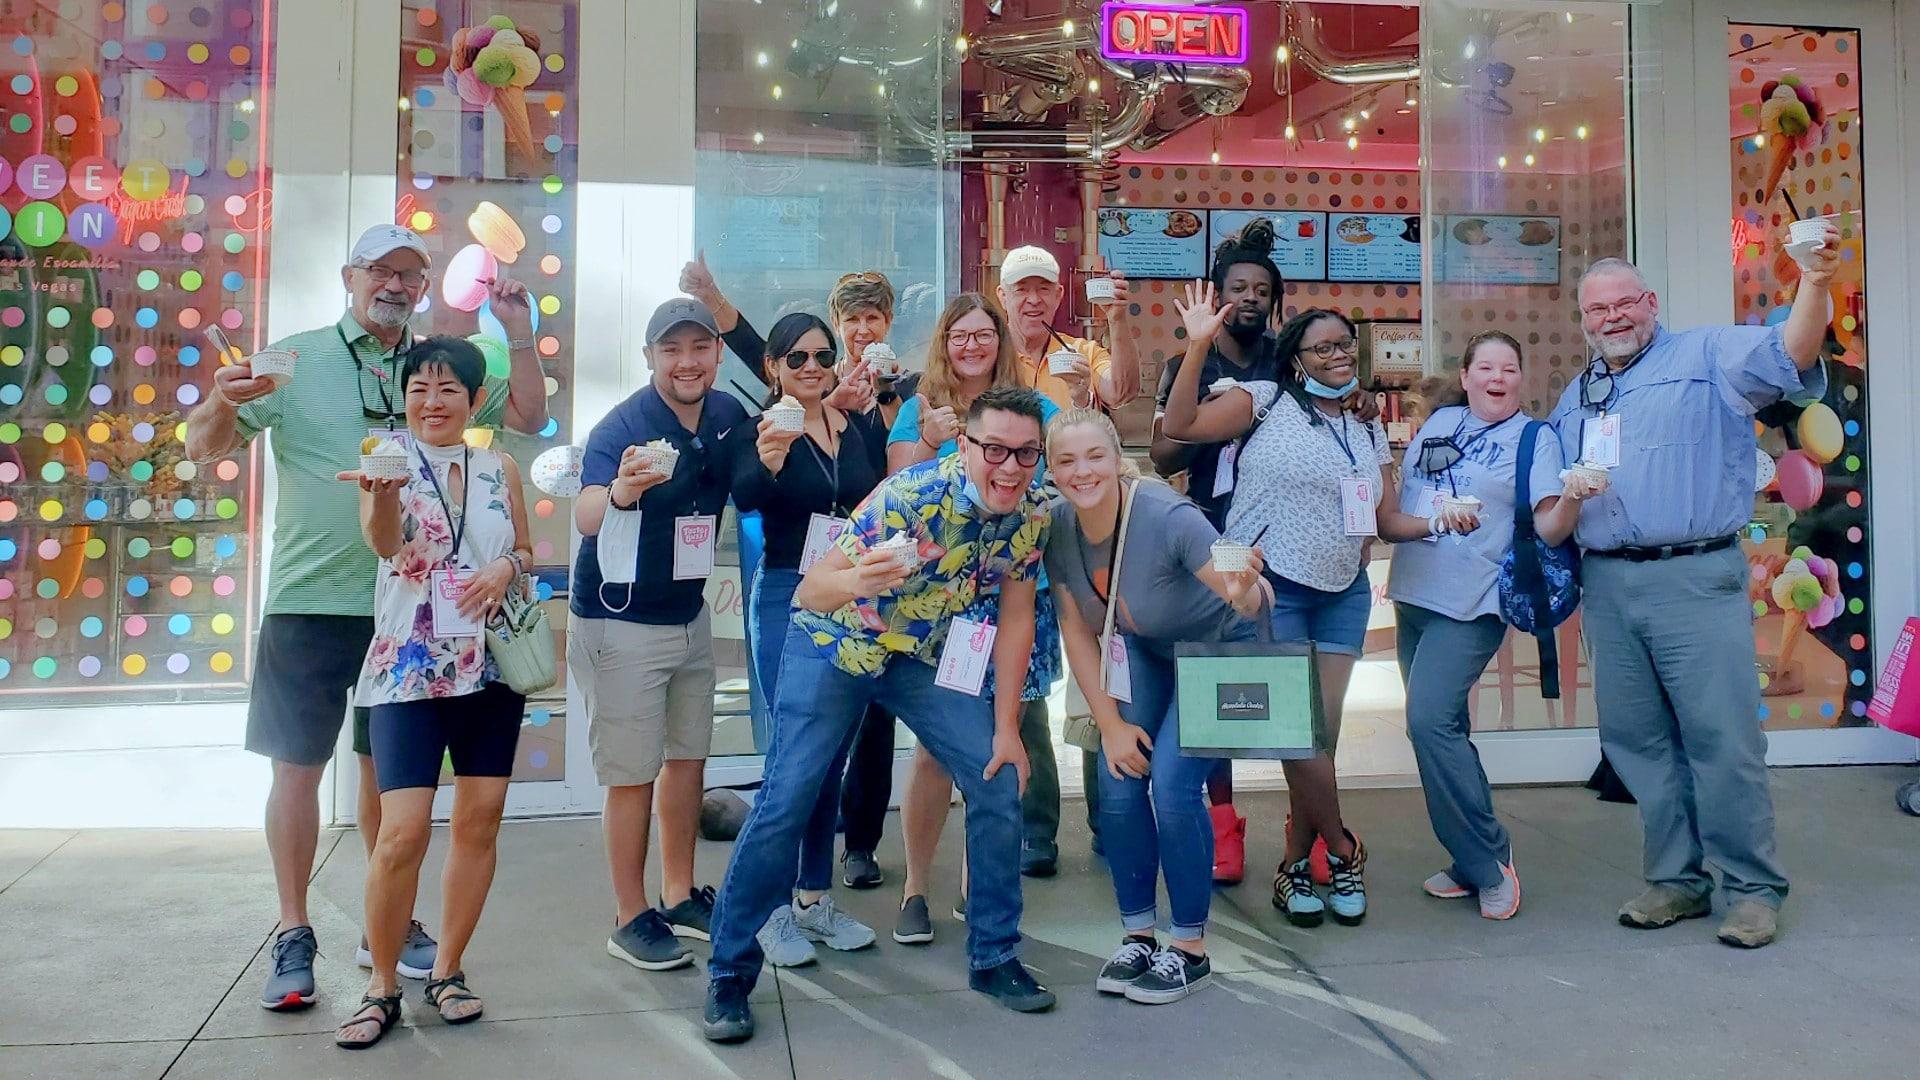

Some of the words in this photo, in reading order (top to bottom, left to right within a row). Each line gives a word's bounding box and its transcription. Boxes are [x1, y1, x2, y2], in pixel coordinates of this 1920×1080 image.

[1112, 9, 1241, 57] OPEN
[0, 164, 156, 191] EET
[31, 280, 77, 293] Vegas
[1381, 331, 1406, 344] Coffee
